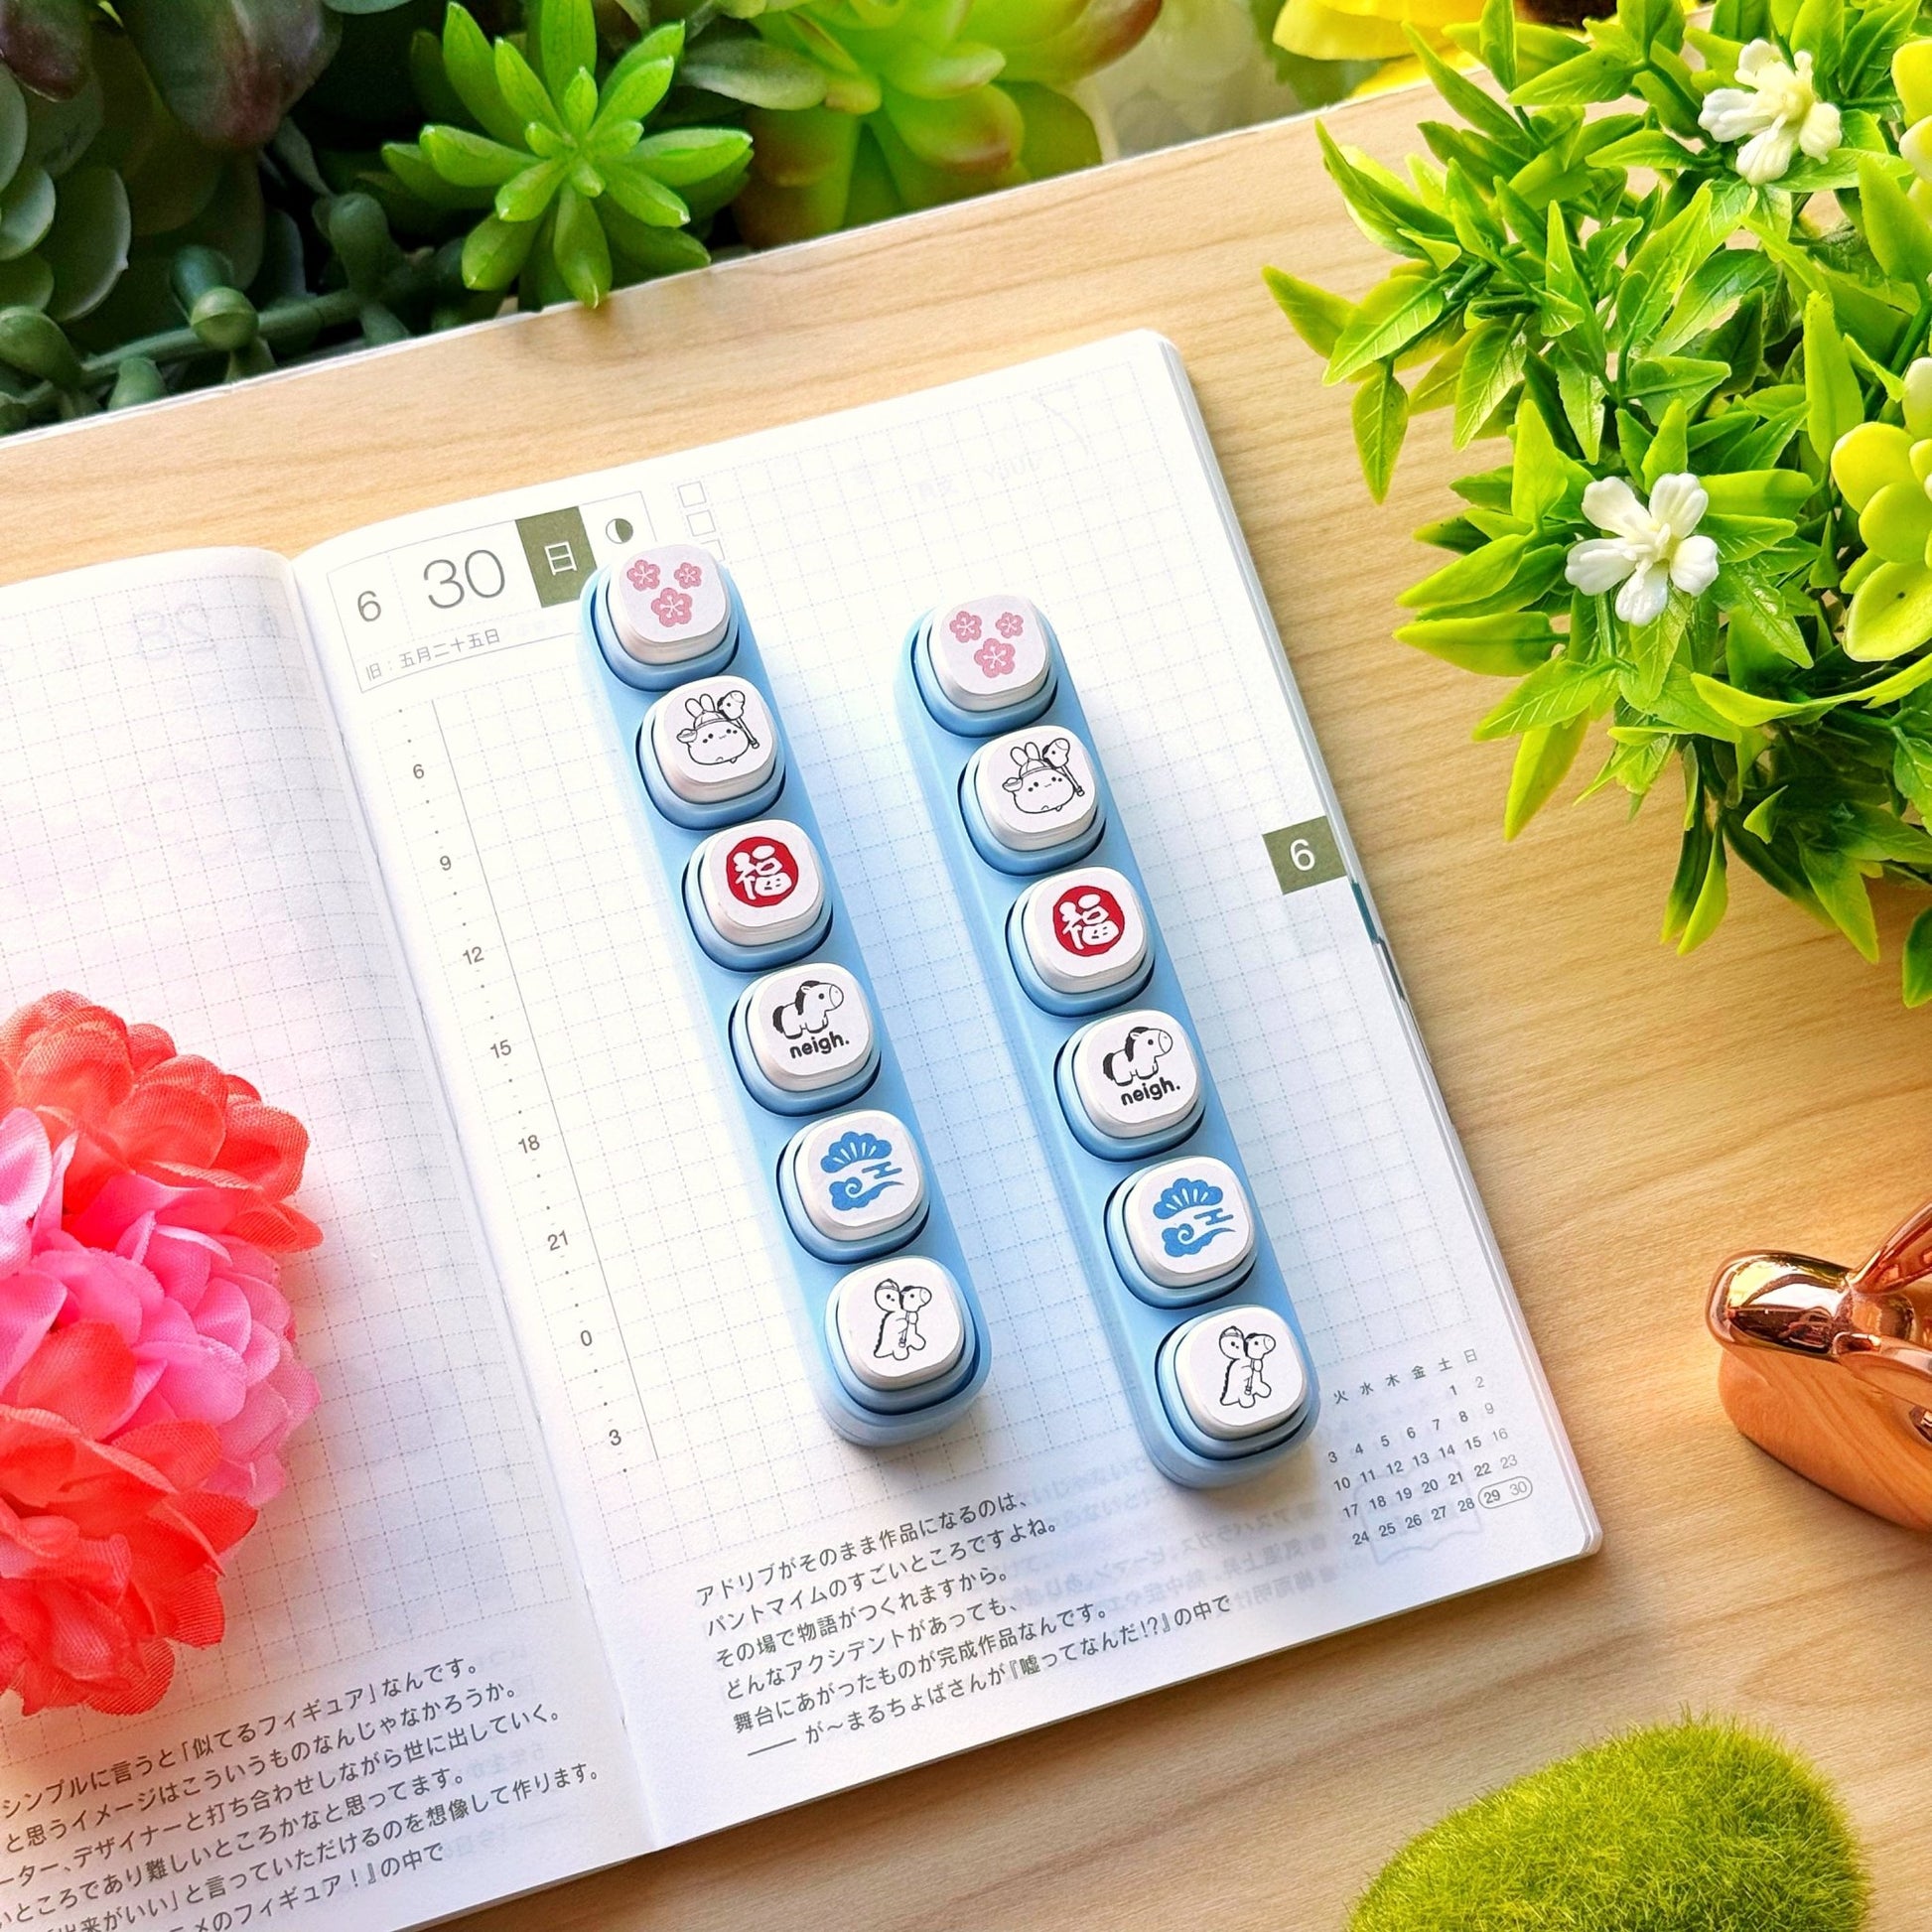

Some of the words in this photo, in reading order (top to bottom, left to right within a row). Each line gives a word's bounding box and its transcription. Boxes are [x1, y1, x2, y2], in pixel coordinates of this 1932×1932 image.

[357, 590, 381, 622] 6
[423, 549, 505, 610] 30
[544, 540, 578, 576] 日
[412, 763, 425, 779] 6
[439, 855, 452, 871] 9
[732, 843, 794, 900] 福
[1289, 838, 1316, 872] 6
[1057, 893, 1120, 950] 福
[463, 945, 484, 966] 12
[489, 1038, 512, 1059] 15
[788, 1031, 851, 1060] neigh.
[1120, 1076, 1181, 1106] neigh.
[517, 1134, 541, 1154] 18
[547, 1230, 570, 1251] 21
[580, 1329, 593, 1346] 0
[1333, 1390, 1348, 1405] 火
[1360, 1382, 1374, 1395] 水
[1386, 1374, 1400, 1387] 木
[1412, 1365, 1426, 1380] 金
[1439, 1358, 1452, 1372] 土
[1463, 1348, 1477, 1363] 日
[1449, 1385, 1457, 1395] 1
[1475, 1376, 1484, 1388] 2
[609, 1429, 621, 1447] 3
[1328, 1451, 1337, 1463] 3
[1355, 1444, 1363, 1455] 4
[1381, 1436, 1390, 1447] 5
[1407, 1427, 1416, 1439] 6
[1433, 1419, 1441, 1431] 7
[1459, 1411, 1468, 1422] 8
[1484, 1403, 1494, 1415] 9
[1334, 1477, 1350, 1491] 10
[1360, 1470, 1376, 1483] 11
[1387, 1461, 1403, 1475] 12
[1413, 1452, 1430, 1466] 13
[1439, 1445, 1455, 1458] 14
[1464, 1437, 1481, 1450] 15
[1492, 1428, 1508, 1442] 16
[1343, 1504, 1358, 1518] 17
[1369, 1496, 1386, 1510] 18
[1396, 1487, 1413, 1502] 19
[1422, 1479, 1439, 1493] 20
[1448, 1471, 1463, 1485] 21
[1474, 1462, 1491, 1476] 22
[1500, 1454, 1517, 1468] 23
[1353, 1531, 1369, 1545] 24
[1379, 1523, 1396, 1537] 25
[1405, 1514, 1422, 1529] 26
[1431, 1506, 1447, 1520] 27
[1457, 1497, 1474, 1512] 28
[1483, 1490, 1500, 1503] 29
[1510, 1481, 1527, 1495] 30
[696, 1491, 1027, 1606] アドリブがそのまま作品になるのは、
[708, 1517, 1056, 1637] パントマイムのすごいところですよね。
[716, 1566, 1008, 1668] その場で物語がつくれますから。
[727, 1597, 1018, 1701] どんなアクシデントがあっても、
[733, 1602, 1106, 1734] 舞台にあがったものが完成作品なんです。
